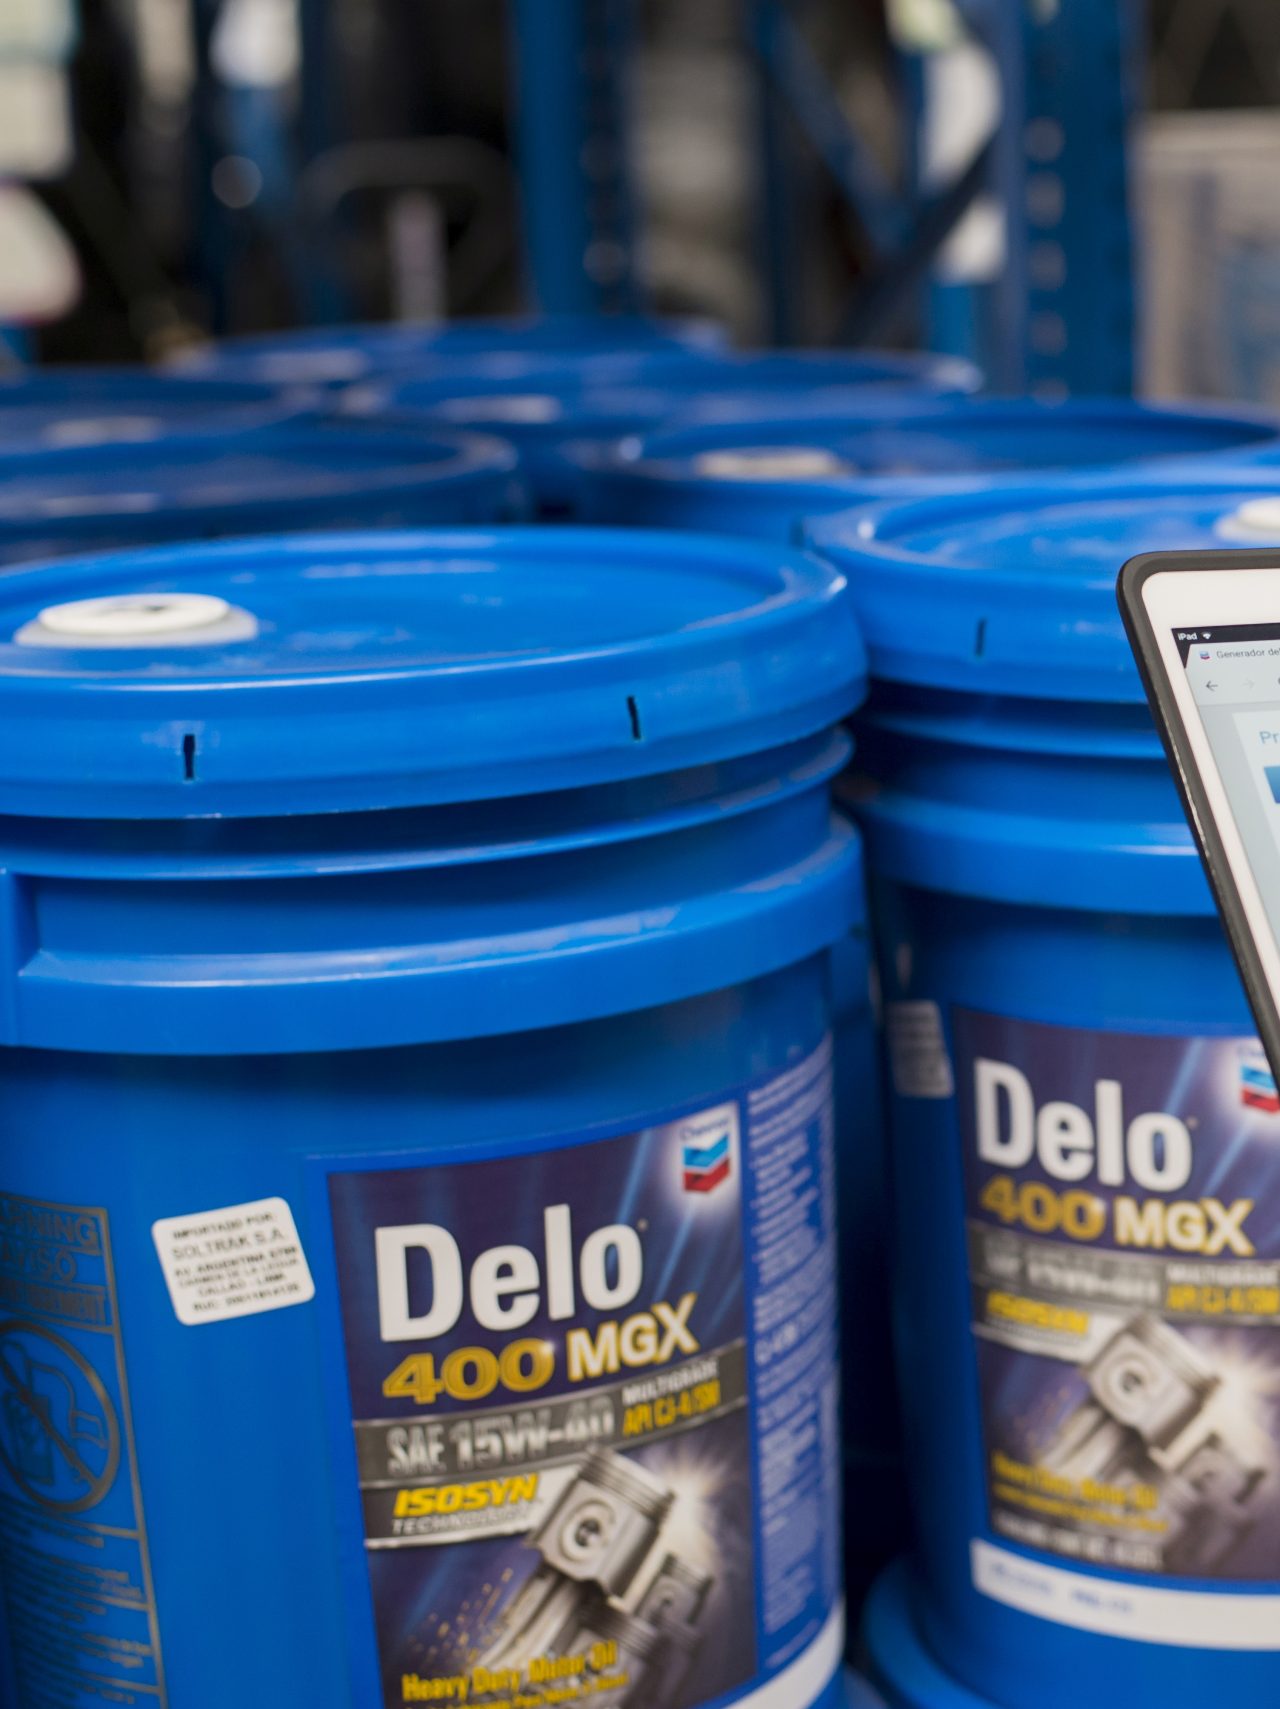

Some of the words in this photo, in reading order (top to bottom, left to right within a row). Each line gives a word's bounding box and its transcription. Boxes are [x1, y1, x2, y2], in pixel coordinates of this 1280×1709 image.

[1177, 632, 1198, 641] iPad
[1216, 650, 1265, 659] Generador
[973, 1058, 1193, 1191] Delo
[980, 1174, 1105, 1240] 400
[1114, 1196, 1255, 1257] MGX
[172, 1236, 252, 1260] SOLTRAK
[375, 1203, 643, 1342] Delo
[383, 1338, 555, 1404] 400
[567, 1293, 700, 1384] MGX
[386, 1423, 447, 1472] SAE
[450, 1397, 615, 1468] 15W-40
[393, 1472, 540, 1518] ISOSYN
[401, 1673, 470, 1703] Heavy
[472, 1665, 521, 1694] Duty
